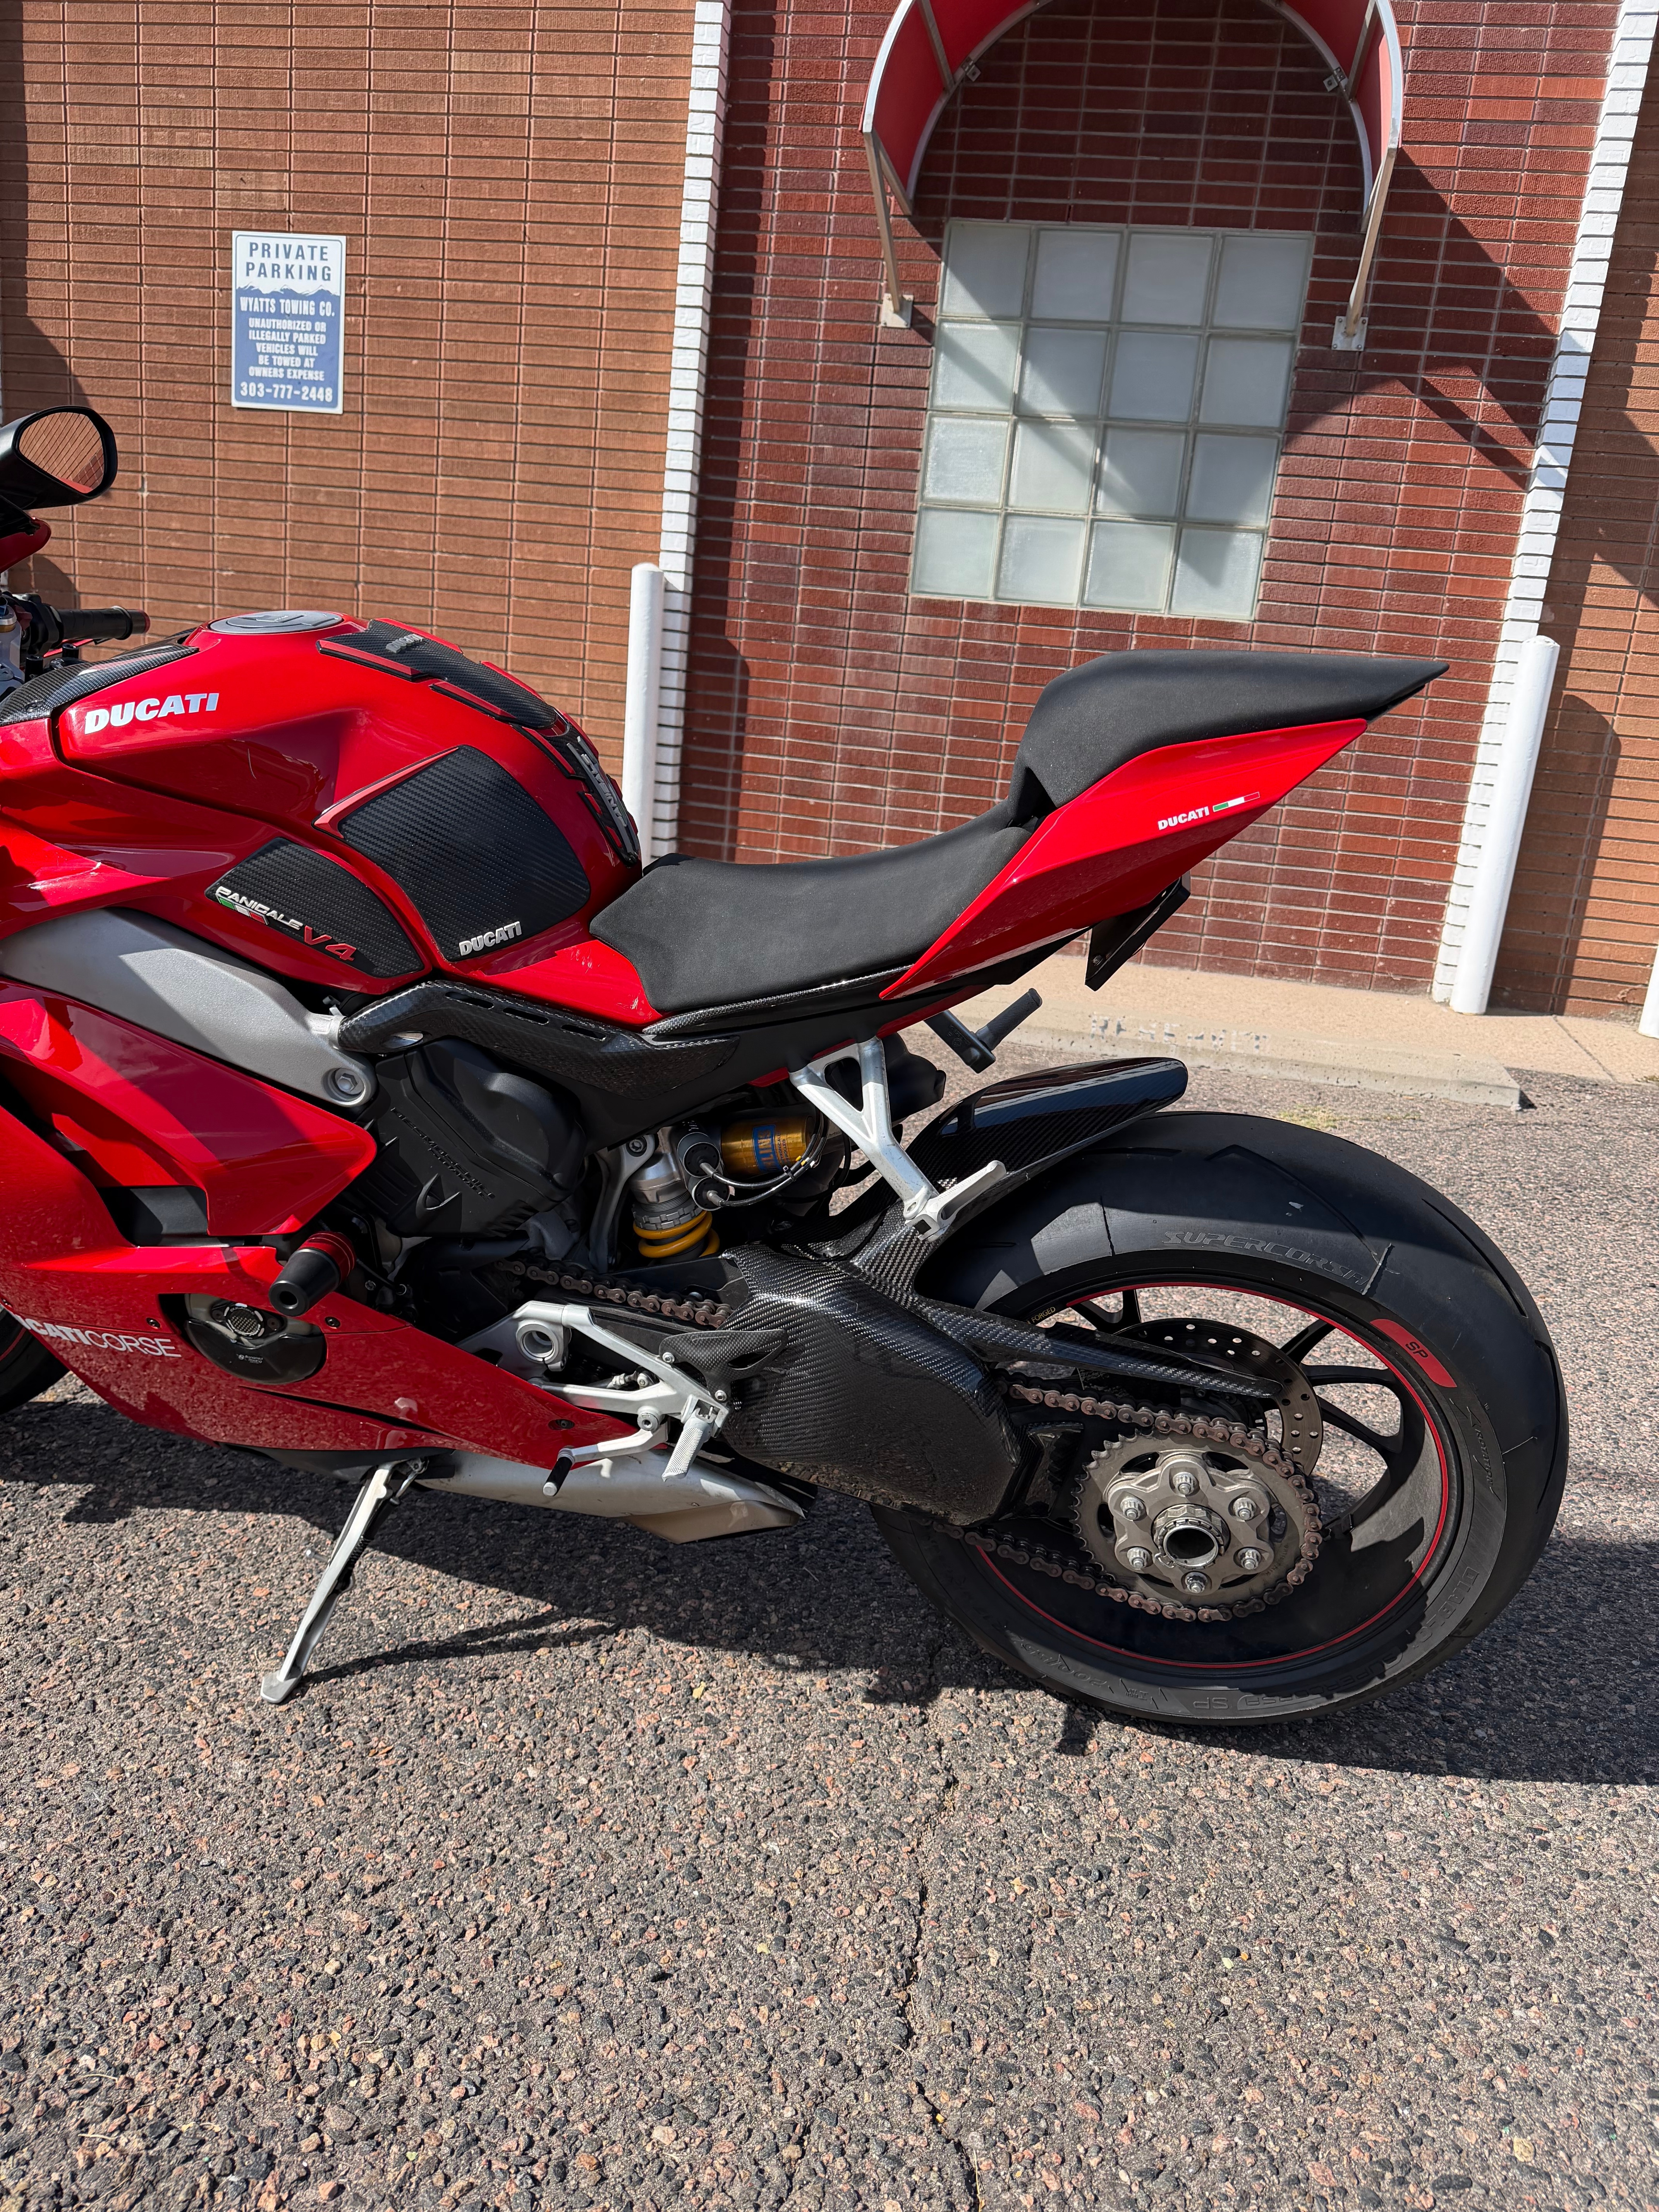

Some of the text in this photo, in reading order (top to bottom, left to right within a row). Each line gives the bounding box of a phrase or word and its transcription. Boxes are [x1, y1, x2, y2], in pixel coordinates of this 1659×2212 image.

[249, 242, 329, 261] PRIVATE
[246, 261, 331, 282] PARKING
[240, 297, 335, 316] WYATTS TOWING CO.
[249, 318, 326, 332] UNAUTHORIZED OR
[249, 330, 326, 344] ILLEGALLY PARKED
[256, 343, 318, 356] VEHICLES WILL
[258, 355, 315, 368] BE TOWED AT
[249, 366, 325, 381] OWNERS EXPENSE
[240, 381, 333, 402] 303-777-2448
[84, 693, 219, 735] DUCATI
[1158, 806, 1210, 831] DUCATI
[215, 886, 357, 962] PANIGALE V4
[459, 921, 522, 957] DUCATI
[1031, 1307, 1056, 1323] FORGED
[1405, 1341, 1428, 1358] SP
[1193, 1697, 1228, 1709] SP
